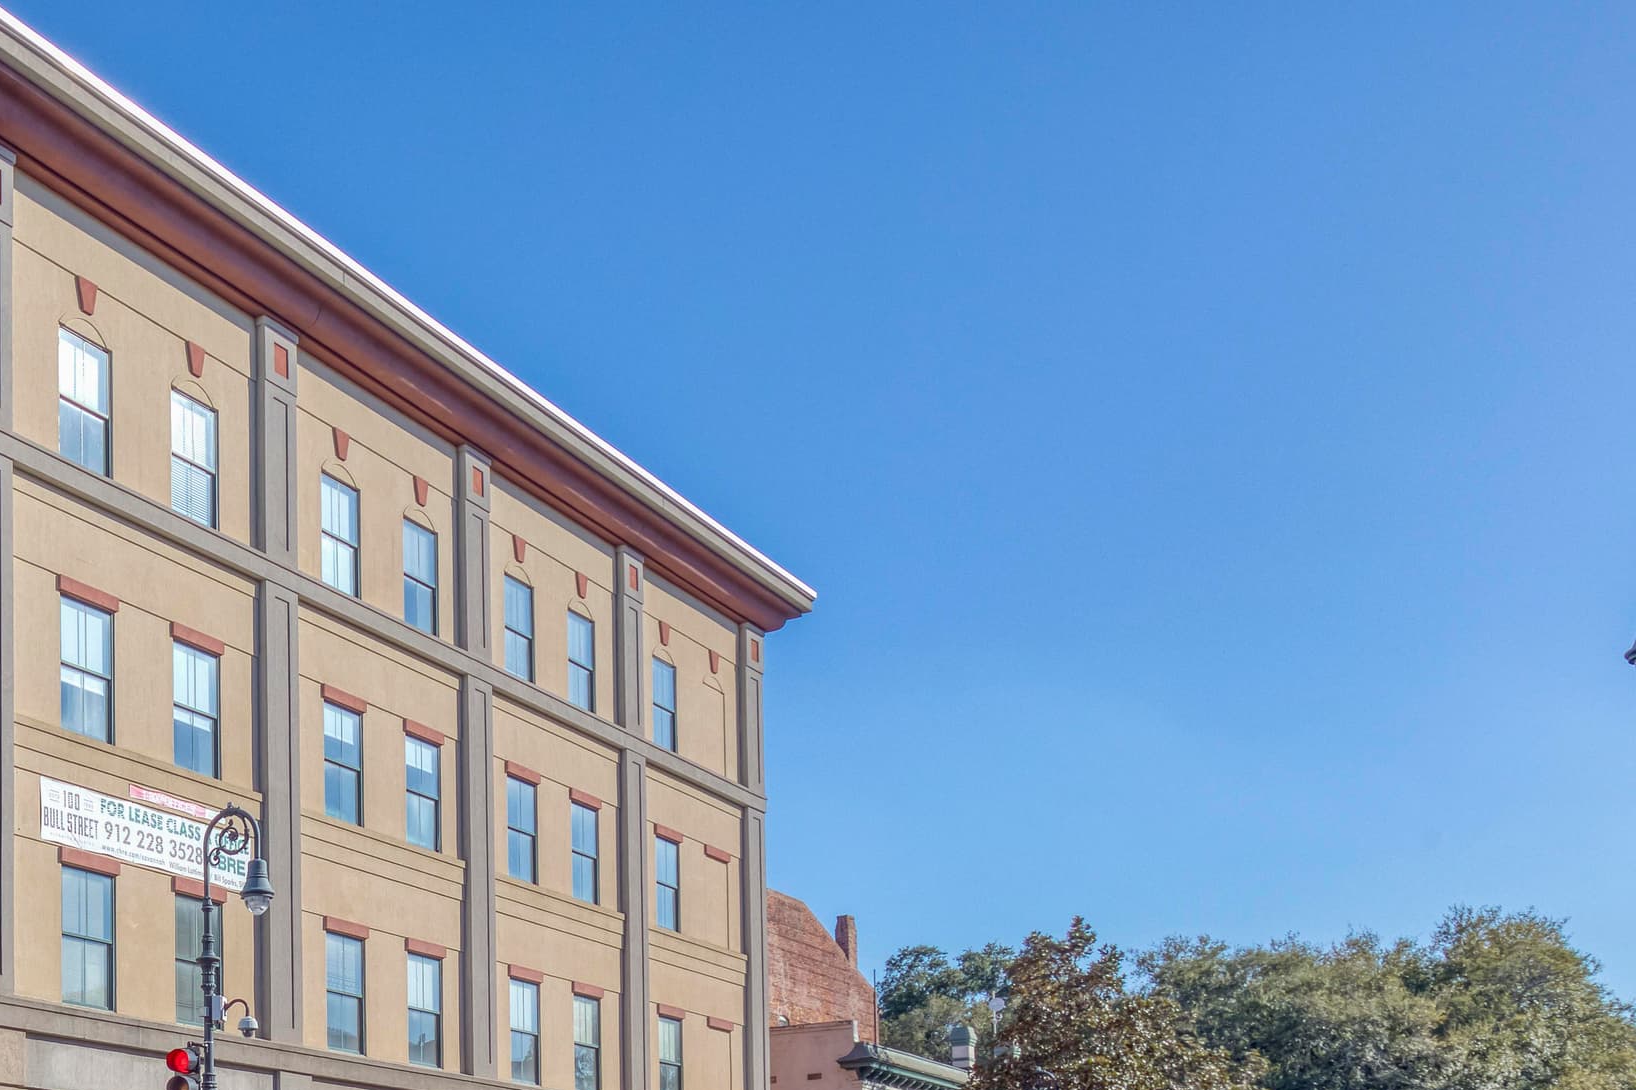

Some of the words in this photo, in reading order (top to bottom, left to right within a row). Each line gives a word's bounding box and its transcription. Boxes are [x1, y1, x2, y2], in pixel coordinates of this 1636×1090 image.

[63, 790, 80, 811] 100
[44, 806, 65, 831] BULL
[67, 812, 99, 840] STREET
[101, 798, 125, 820] FOR
[128, 805, 163, 831] LEASE
[166, 818, 202, 842] CLASS
[104, 821, 131, 846] 912
[136, 830, 164, 854] 228
[169, 839, 203, 866] 3528
[211, 851, 246, 878] BRE
